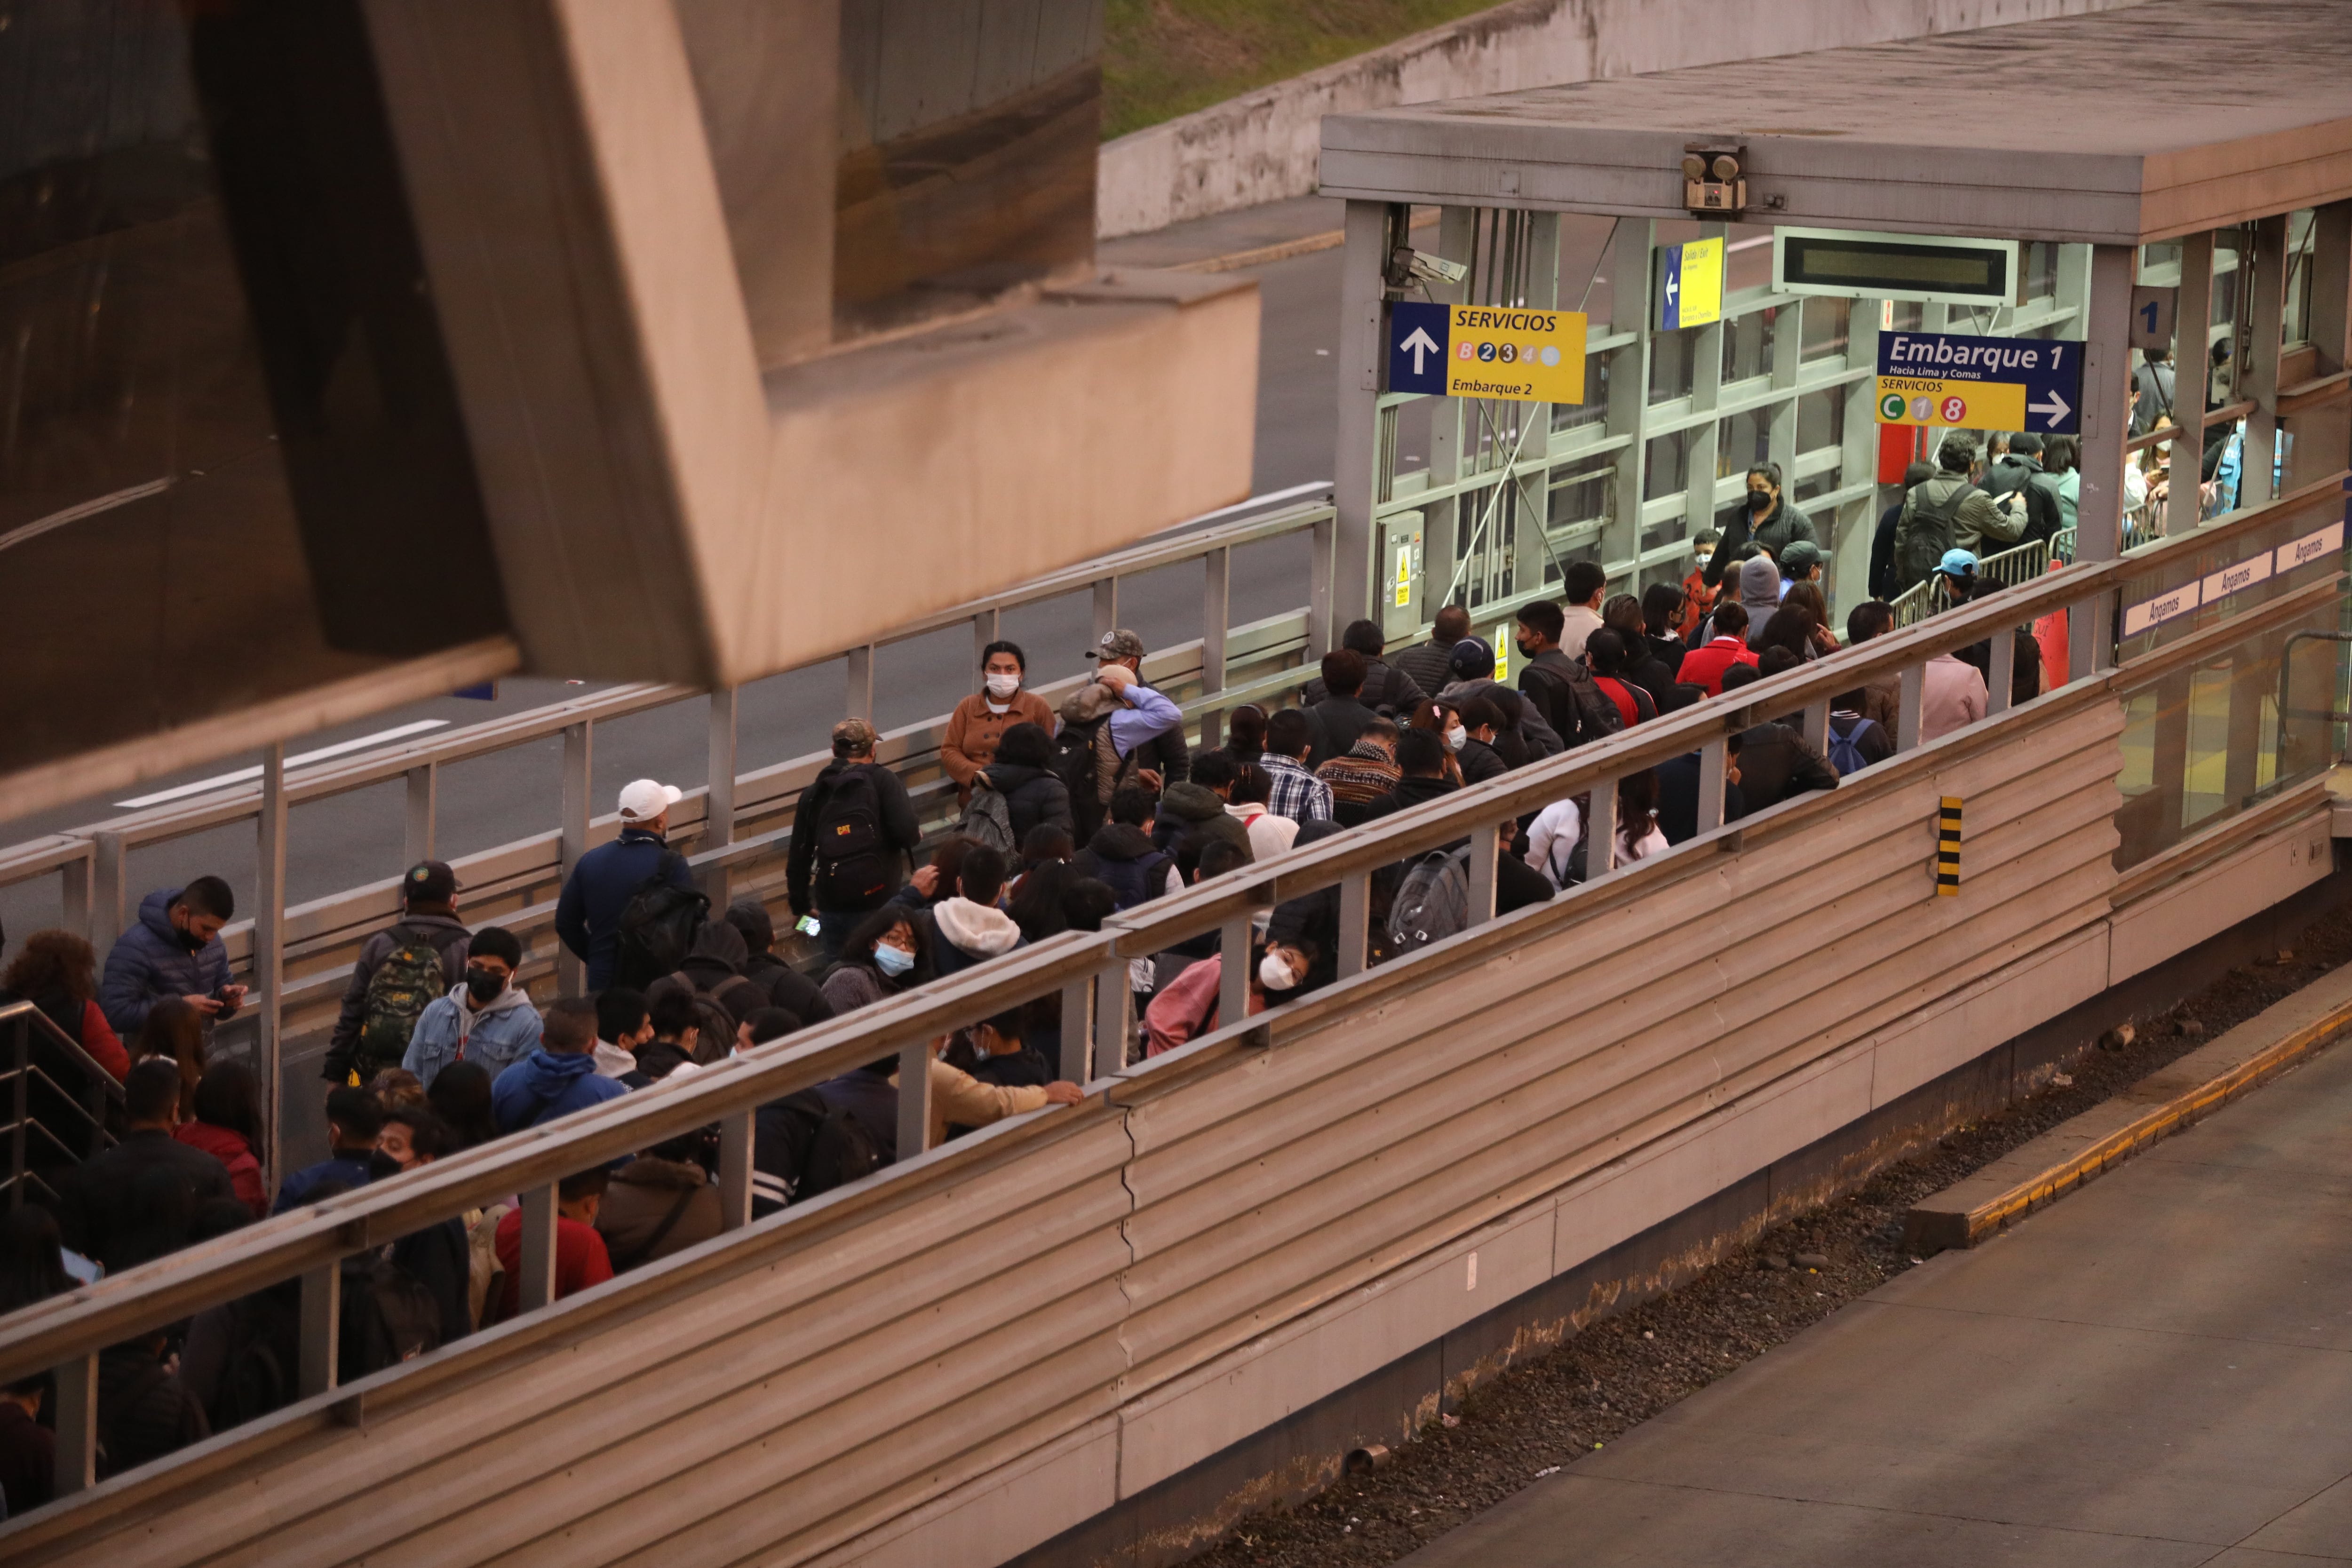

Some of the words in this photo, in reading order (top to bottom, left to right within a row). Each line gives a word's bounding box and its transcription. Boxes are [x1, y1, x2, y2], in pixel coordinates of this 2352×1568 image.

[1456, 310, 1557, 332] SERVICIOS
[2140, 301, 2158, 334] 1
[1459, 342, 1473, 359] B
[1480, 345, 1493, 360] 2
[1502, 344, 1514, 362] 3
[1522, 348, 1534, 361] 4
[1890, 337, 2038, 373] Embarque
[2050, 346, 2063, 370] 1
[1889, 365, 1915, 375] Hacia
[1917, 366, 1939, 376] Lima
[1941, 370, 1948, 379] y
[1950, 369, 1981, 379] Comas
[1453, 379, 1521, 396] Embarque
[1524, 383, 1533, 395] 2
[1882, 379, 1943, 392] SERVICIOS
[1883, 396, 1901, 417] C
[1916, 399, 1927, 418] 1
[1945, 398, 1963, 420] 8
[2295, 538, 2322, 563] Angamos
[2221, 567, 2250, 593] Angamos
[2149, 596, 2179, 622] Angamos
[836, 824, 851, 836] CAT
